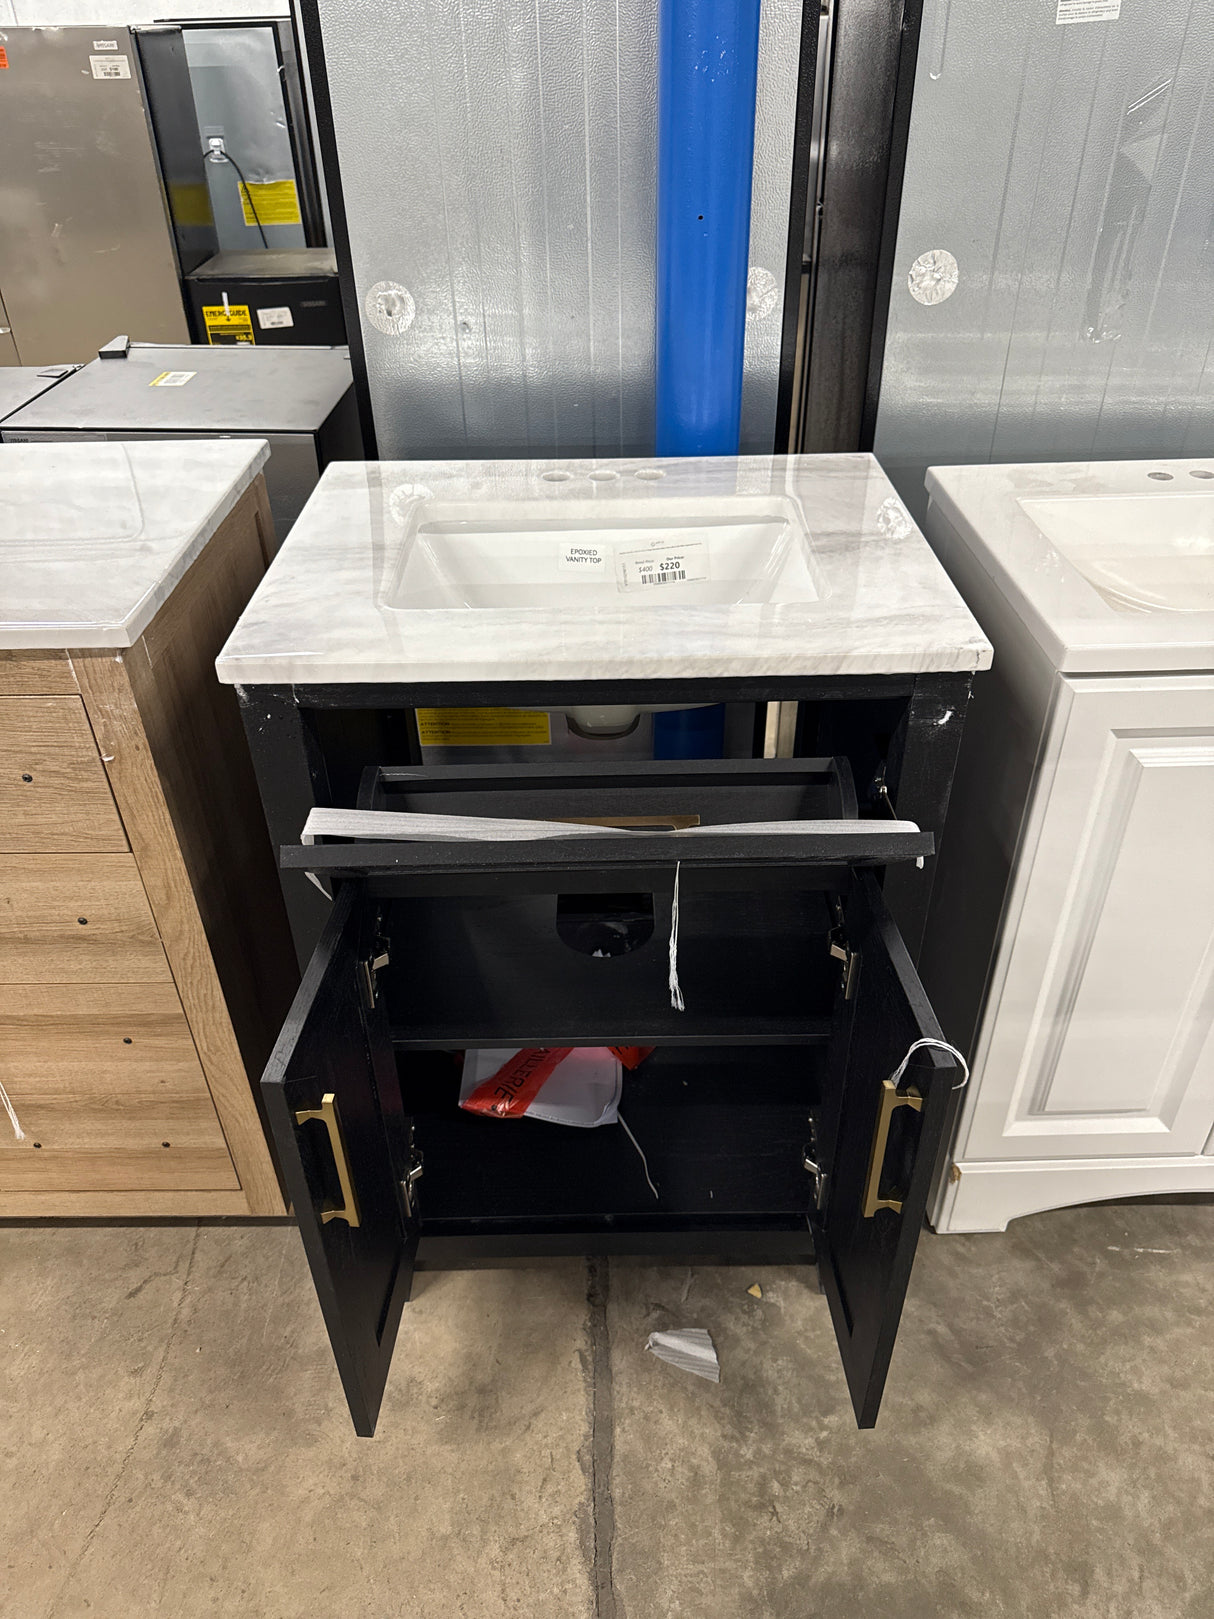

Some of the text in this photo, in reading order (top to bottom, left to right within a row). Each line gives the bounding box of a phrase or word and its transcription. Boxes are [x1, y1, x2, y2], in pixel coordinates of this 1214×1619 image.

[570, 548, 598, 556] EPOXIED
[638, 561, 681, 573] $400 $220
